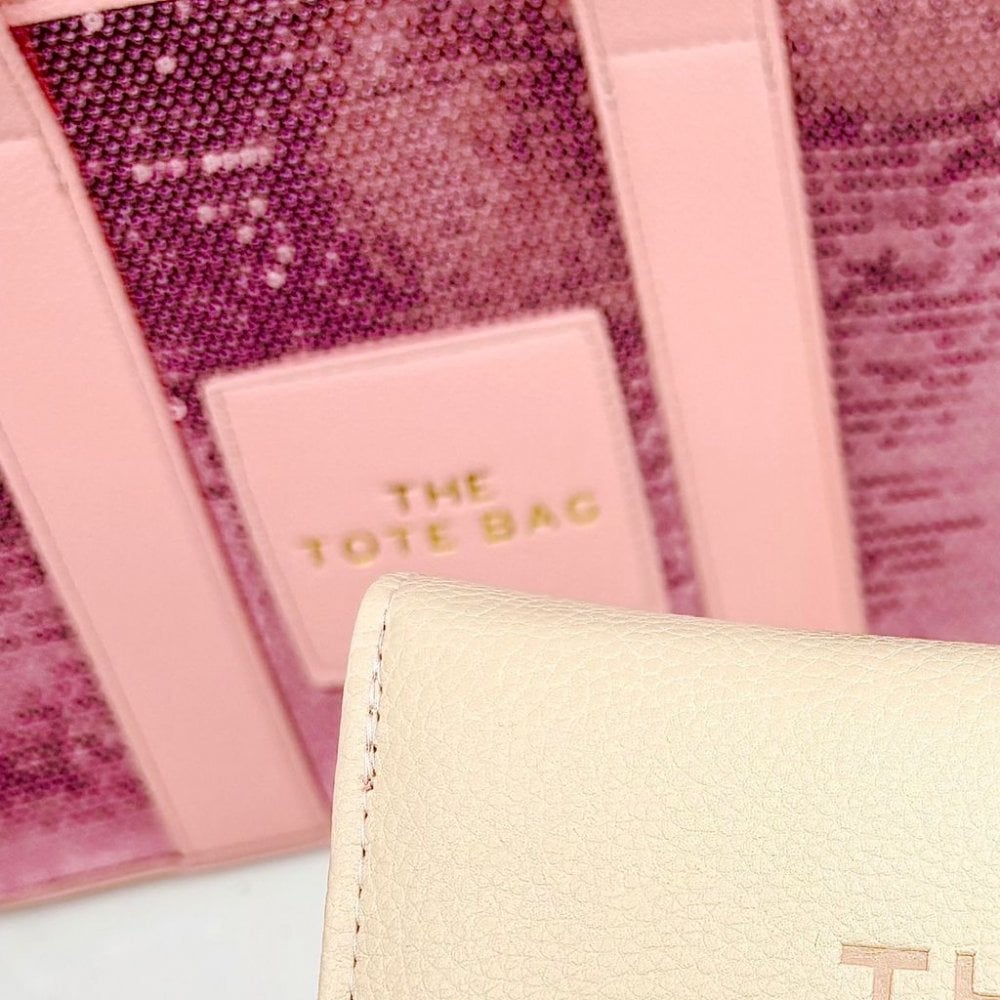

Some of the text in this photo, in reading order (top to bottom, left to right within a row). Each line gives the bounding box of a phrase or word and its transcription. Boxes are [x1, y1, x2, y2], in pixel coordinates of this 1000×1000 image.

[387, 468, 490, 514] THE
[298, 493, 602, 567] TOTE BAG
